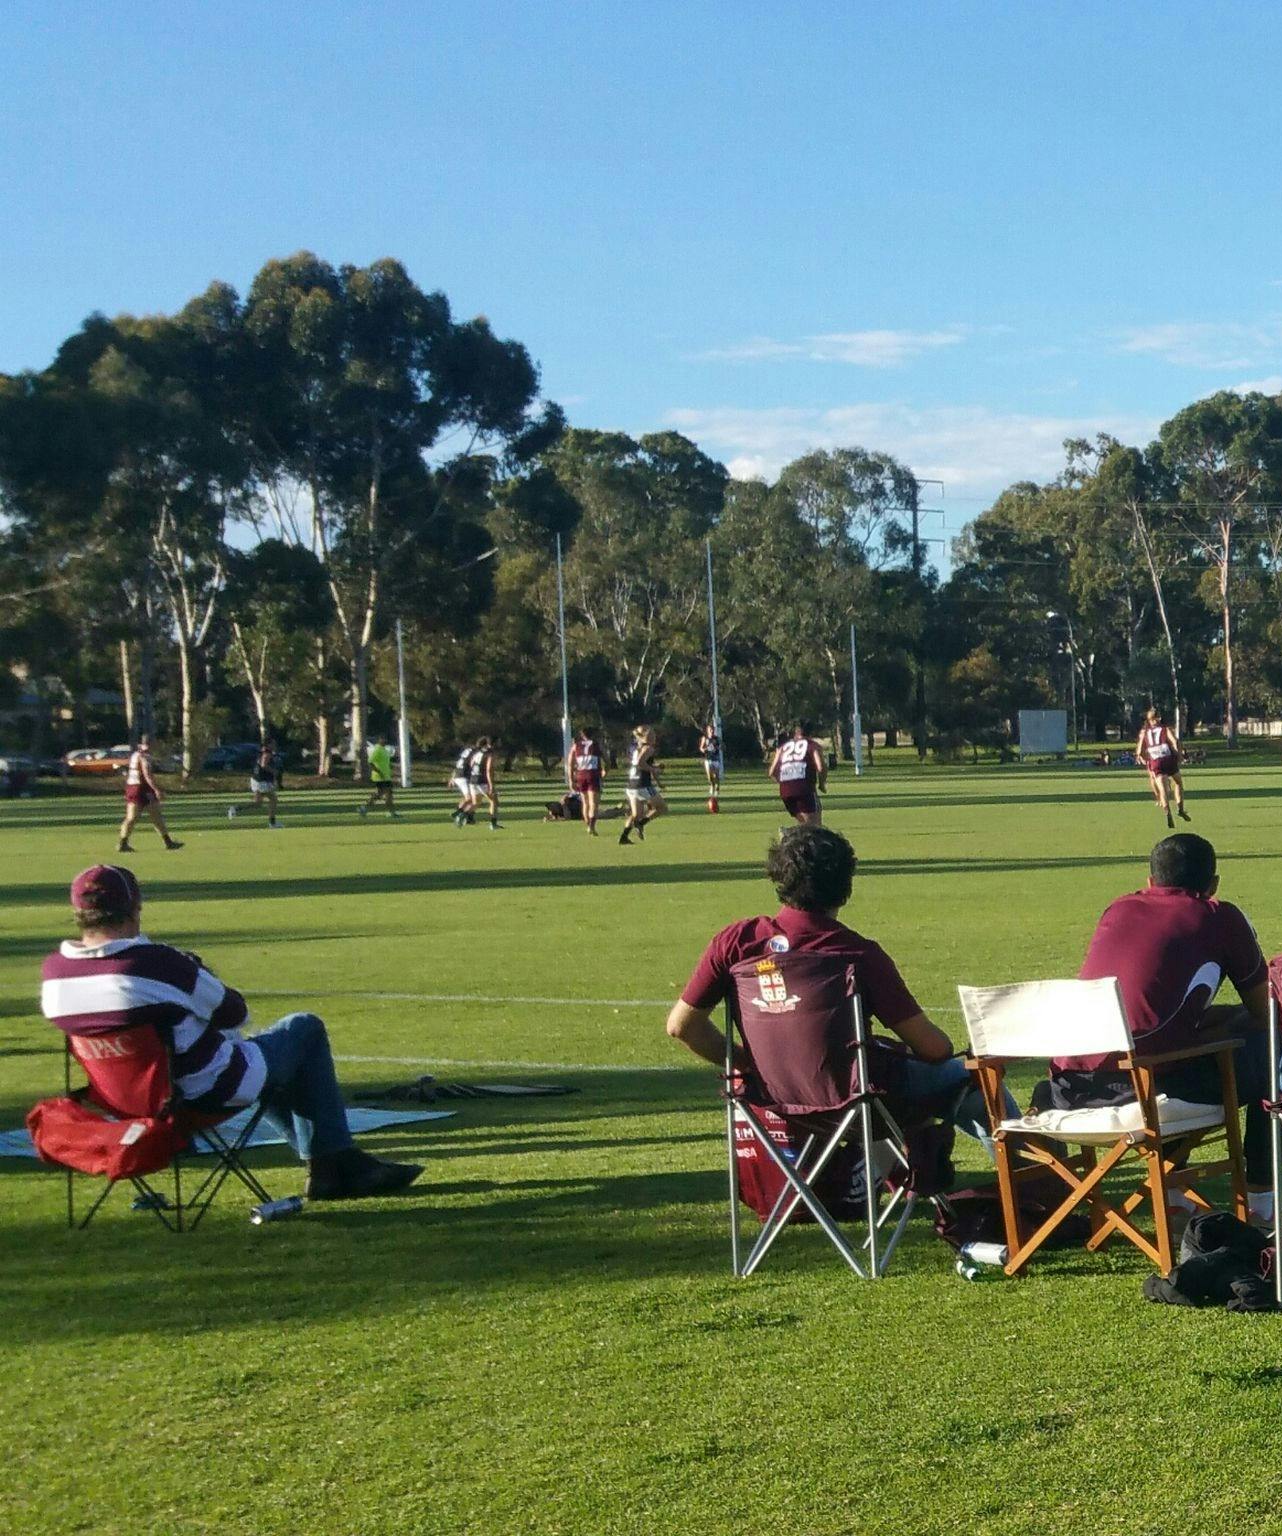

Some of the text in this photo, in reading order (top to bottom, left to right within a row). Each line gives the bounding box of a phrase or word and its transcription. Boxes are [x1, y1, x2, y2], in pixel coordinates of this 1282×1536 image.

[1147, 727, 1162, 746] 17
[582, 740, 593, 755] 7
[782, 739, 808, 764] 29
